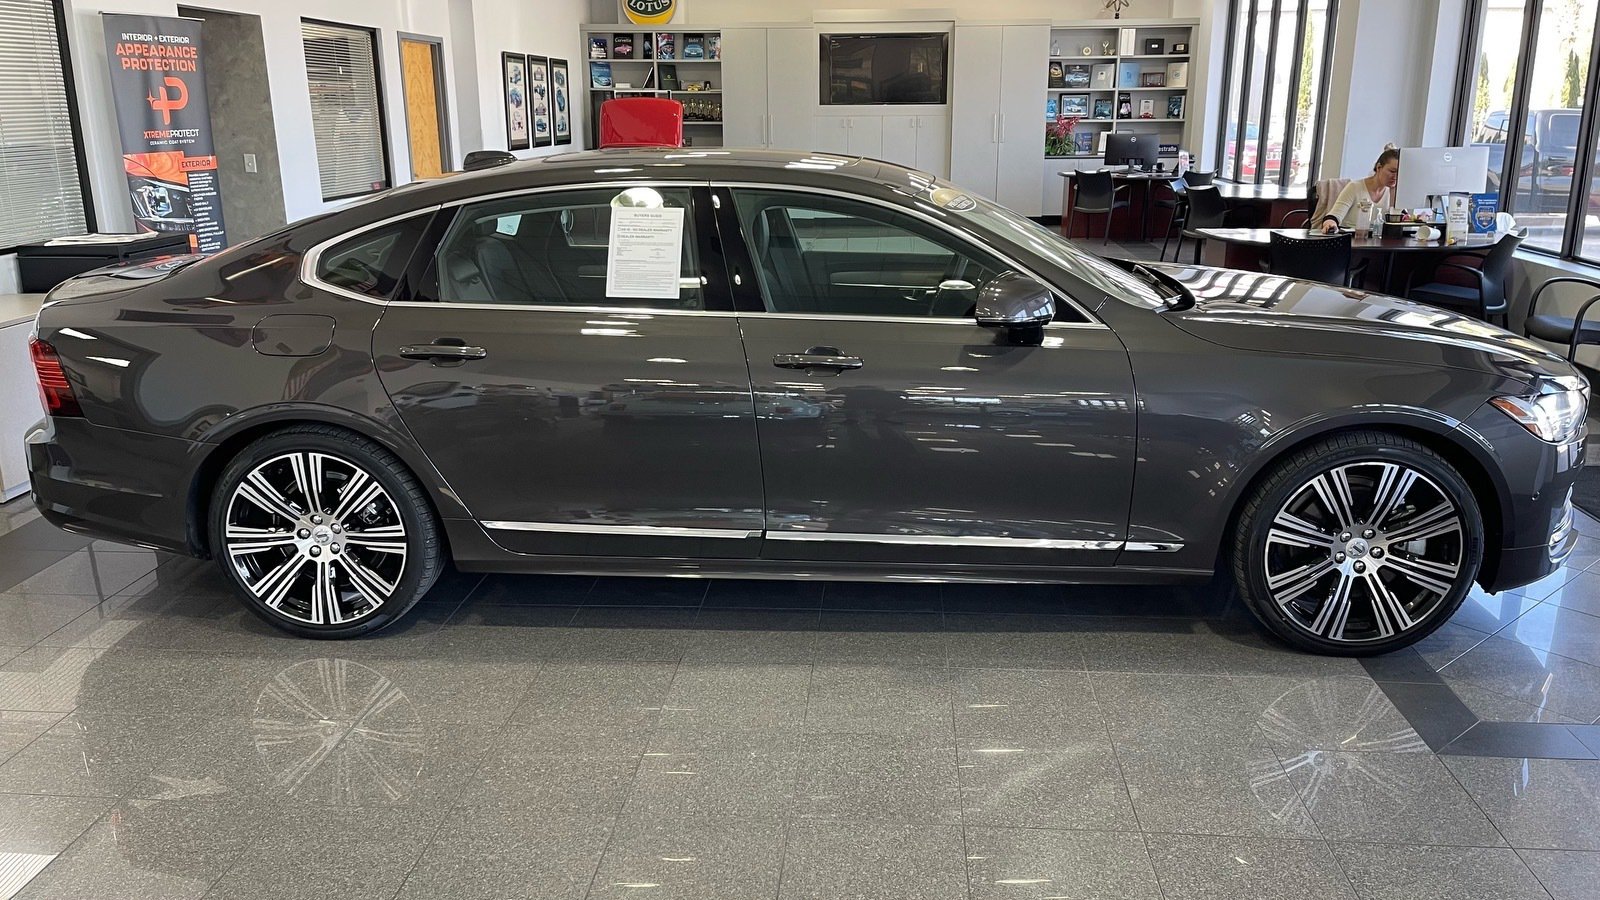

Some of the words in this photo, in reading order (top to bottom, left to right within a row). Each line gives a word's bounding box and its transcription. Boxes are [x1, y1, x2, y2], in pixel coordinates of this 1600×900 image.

[629, 0, 670, 12] LOTUS
[121, 33, 153, 42] INTERIOR
[159, 35, 190, 44] EXTERIOR
[116, 43, 198, 59] APPEARANCE
[121, 58, 197, 72] PROTECTION
[144, 129, 200, 139] XTREMEPROTECT
[181, 159, 211, 169] EXTERIOR
